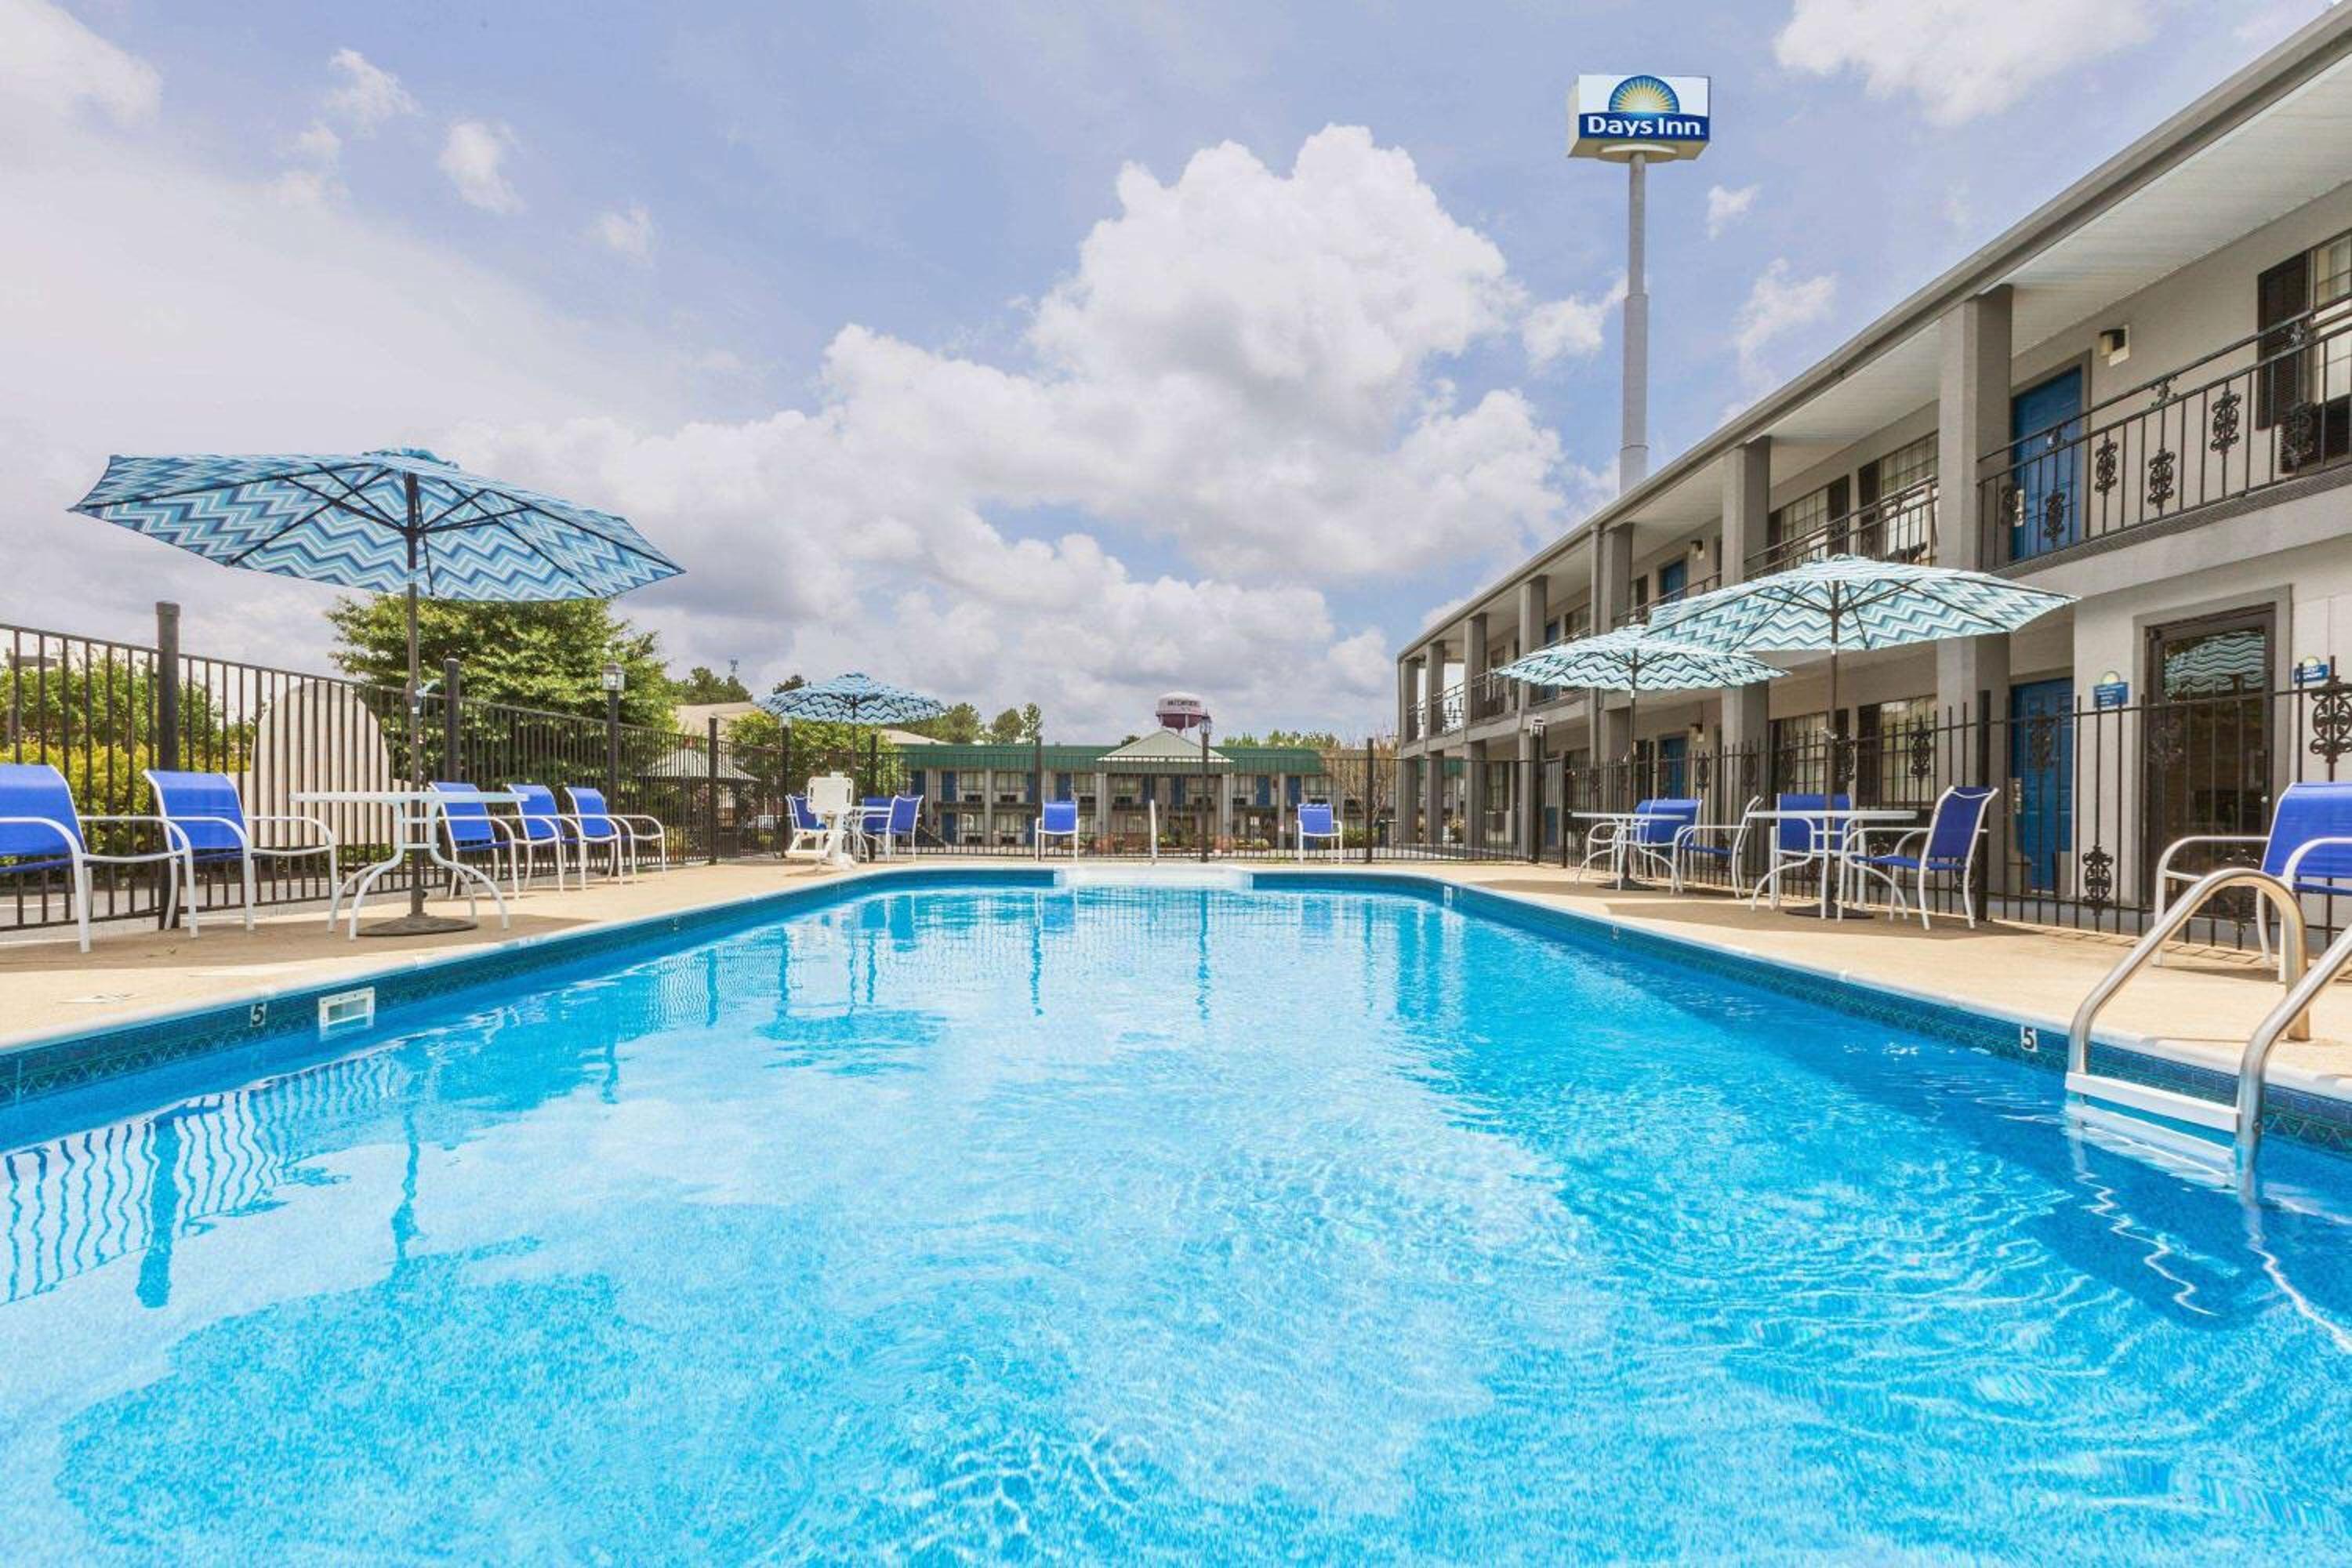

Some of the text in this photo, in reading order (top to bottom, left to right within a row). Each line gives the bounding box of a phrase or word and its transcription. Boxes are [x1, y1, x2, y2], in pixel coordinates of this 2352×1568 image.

[1587, 115, 1701, 137] Days Inn
[252, 1004, 264, 1026] 5
[2024, 1026, 2034, 1049] 5
